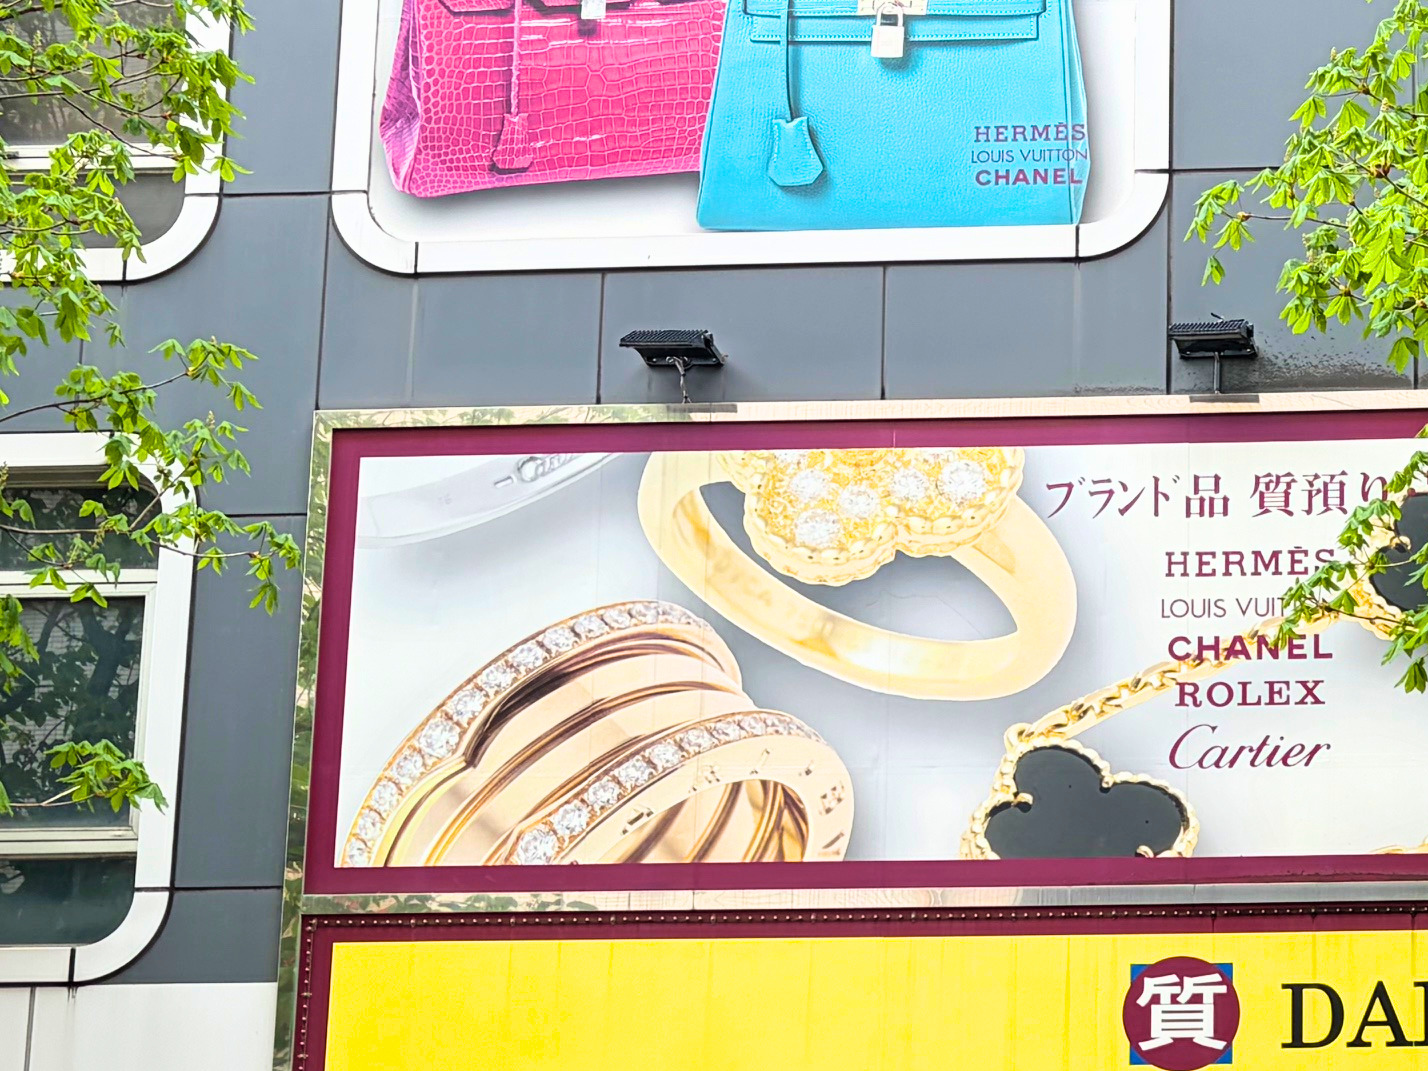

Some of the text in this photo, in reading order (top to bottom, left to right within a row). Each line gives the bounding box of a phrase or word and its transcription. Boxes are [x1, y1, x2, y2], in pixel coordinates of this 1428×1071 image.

[974, 122, 1085, 142] HERMÈS
[971, 149, 1087, 163] LOUIS VUITTON
[975, 168, 1083, 186] CHANEL
[1046, 473, 1230, 518] ブランド品
[1161, 597, 1300, 619] LOUIS VUIT
[1168, 633, 1333, 661] CHANEL
[1175, 680, 1325, 707] ROLEX
[1169, 724, 1331, 769] Cartier
[1137, 972, 1228, 1050] 質
